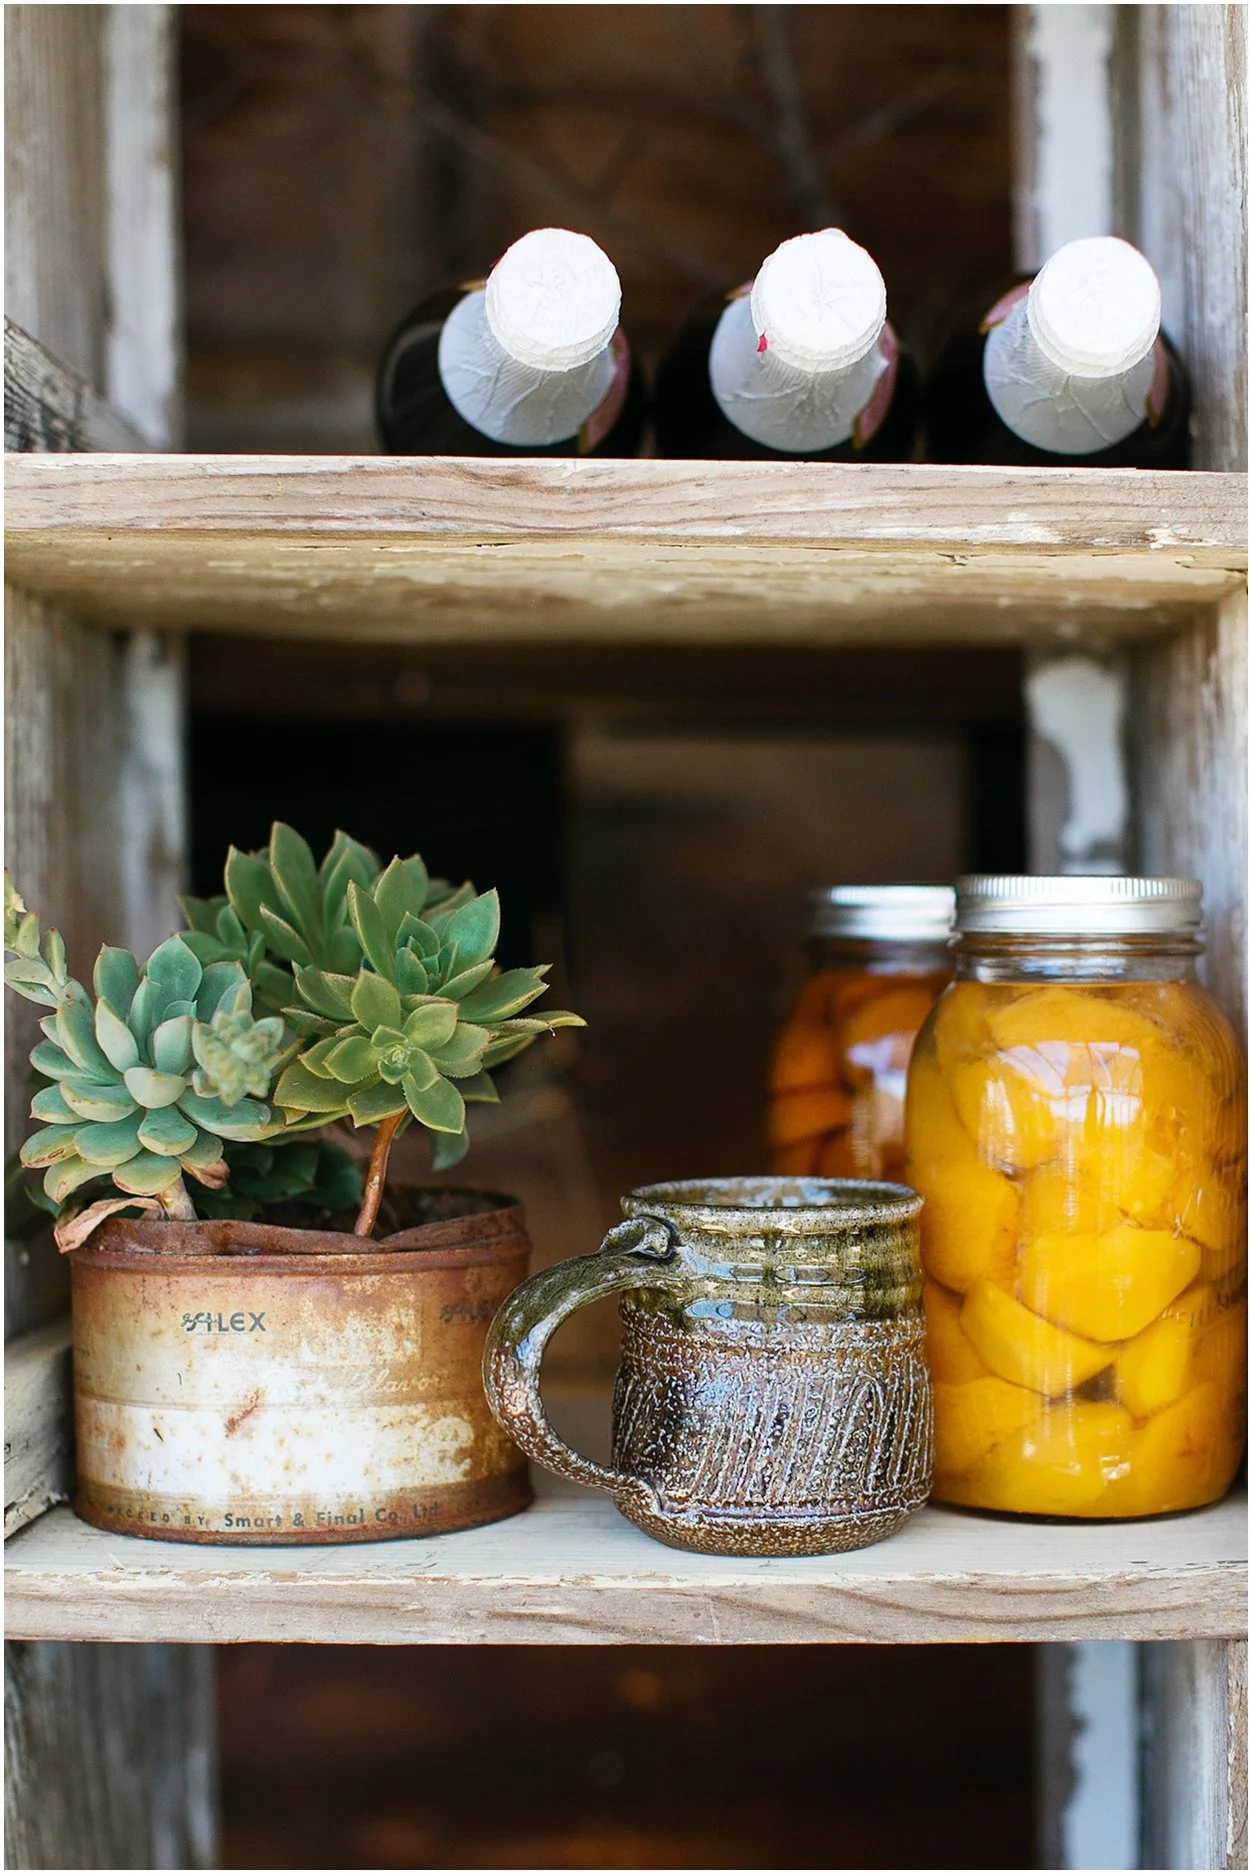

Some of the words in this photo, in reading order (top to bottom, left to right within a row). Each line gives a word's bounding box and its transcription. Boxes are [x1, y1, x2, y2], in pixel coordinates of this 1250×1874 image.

[223, 1512, 282, 1528] Smart
[292, 1512, 305, 1528] &
[316, 1507, 365, 1527] Final
